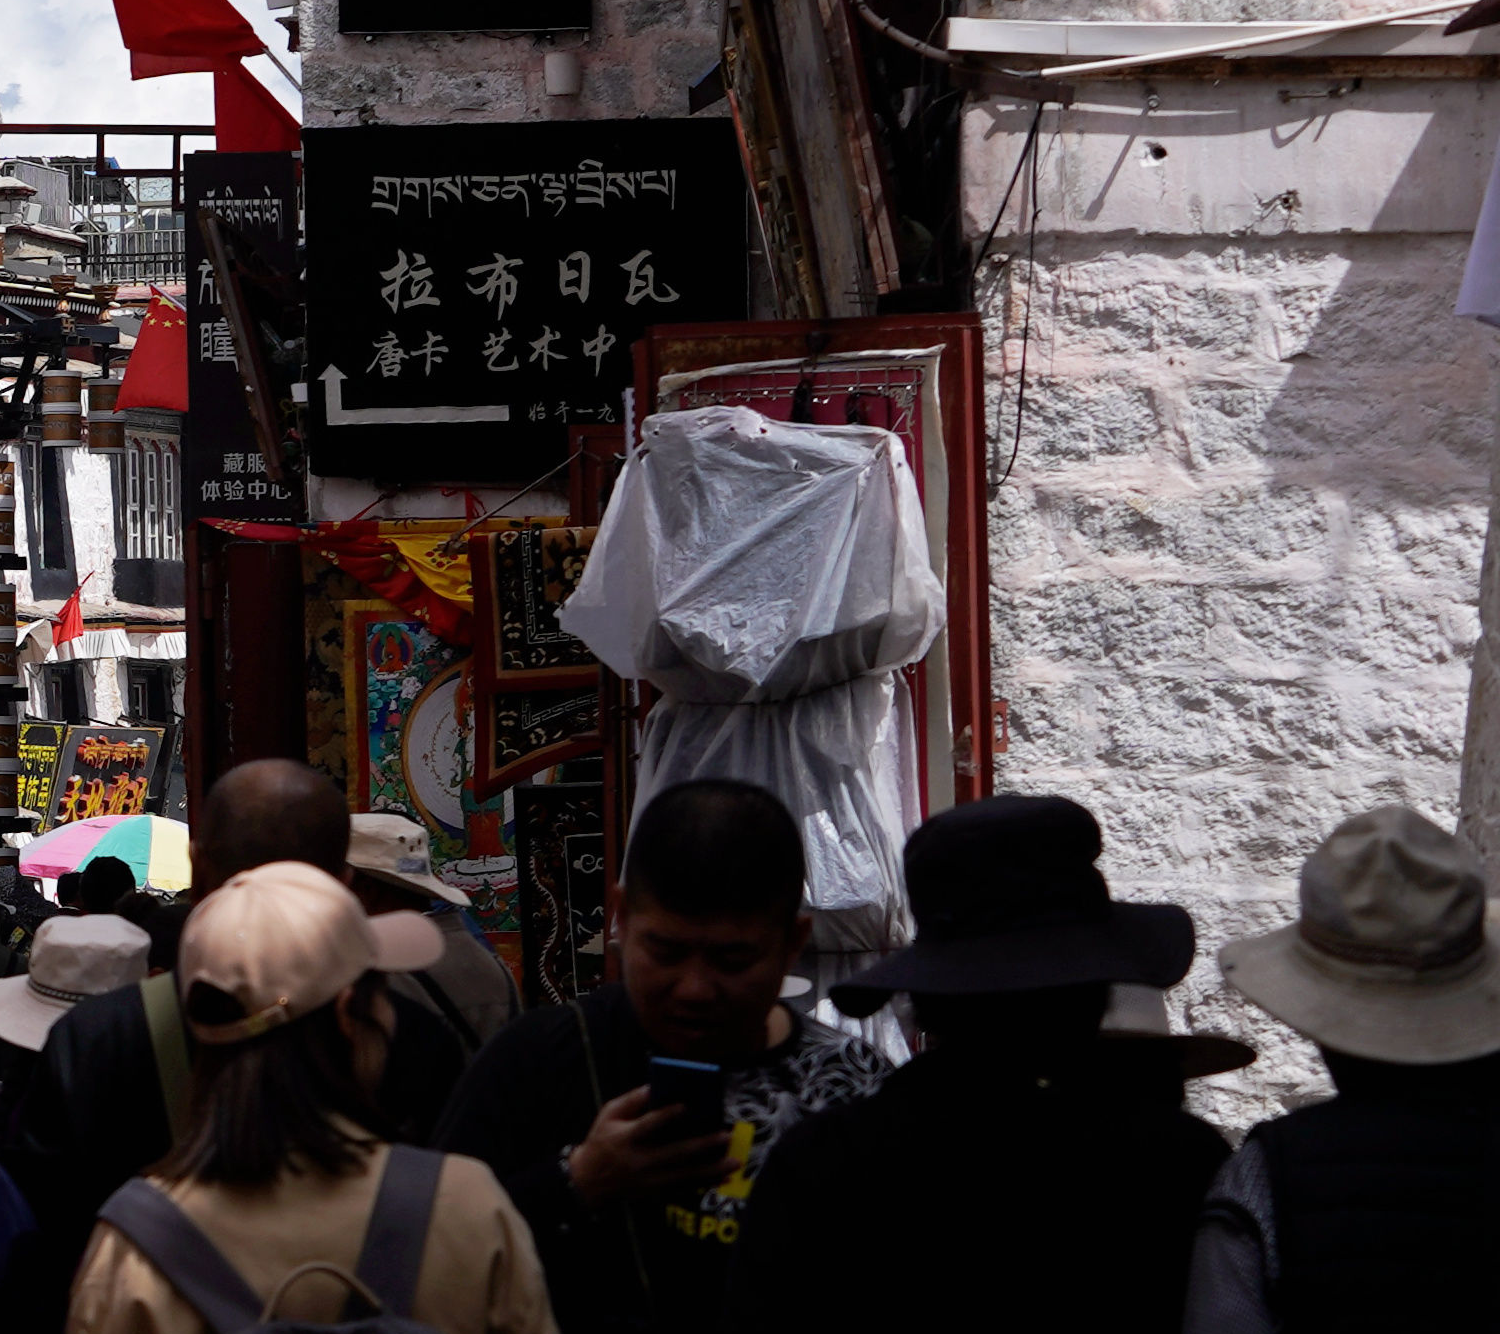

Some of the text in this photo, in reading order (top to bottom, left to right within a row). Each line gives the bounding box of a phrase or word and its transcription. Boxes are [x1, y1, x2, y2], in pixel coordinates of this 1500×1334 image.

[379, 248, 681, 320] 拉布日瓦
[528, 400, 616, 424] 始于一九
[223, 453, 268, 474] 藏服
[200, 480, 293, 503] 体验中心
